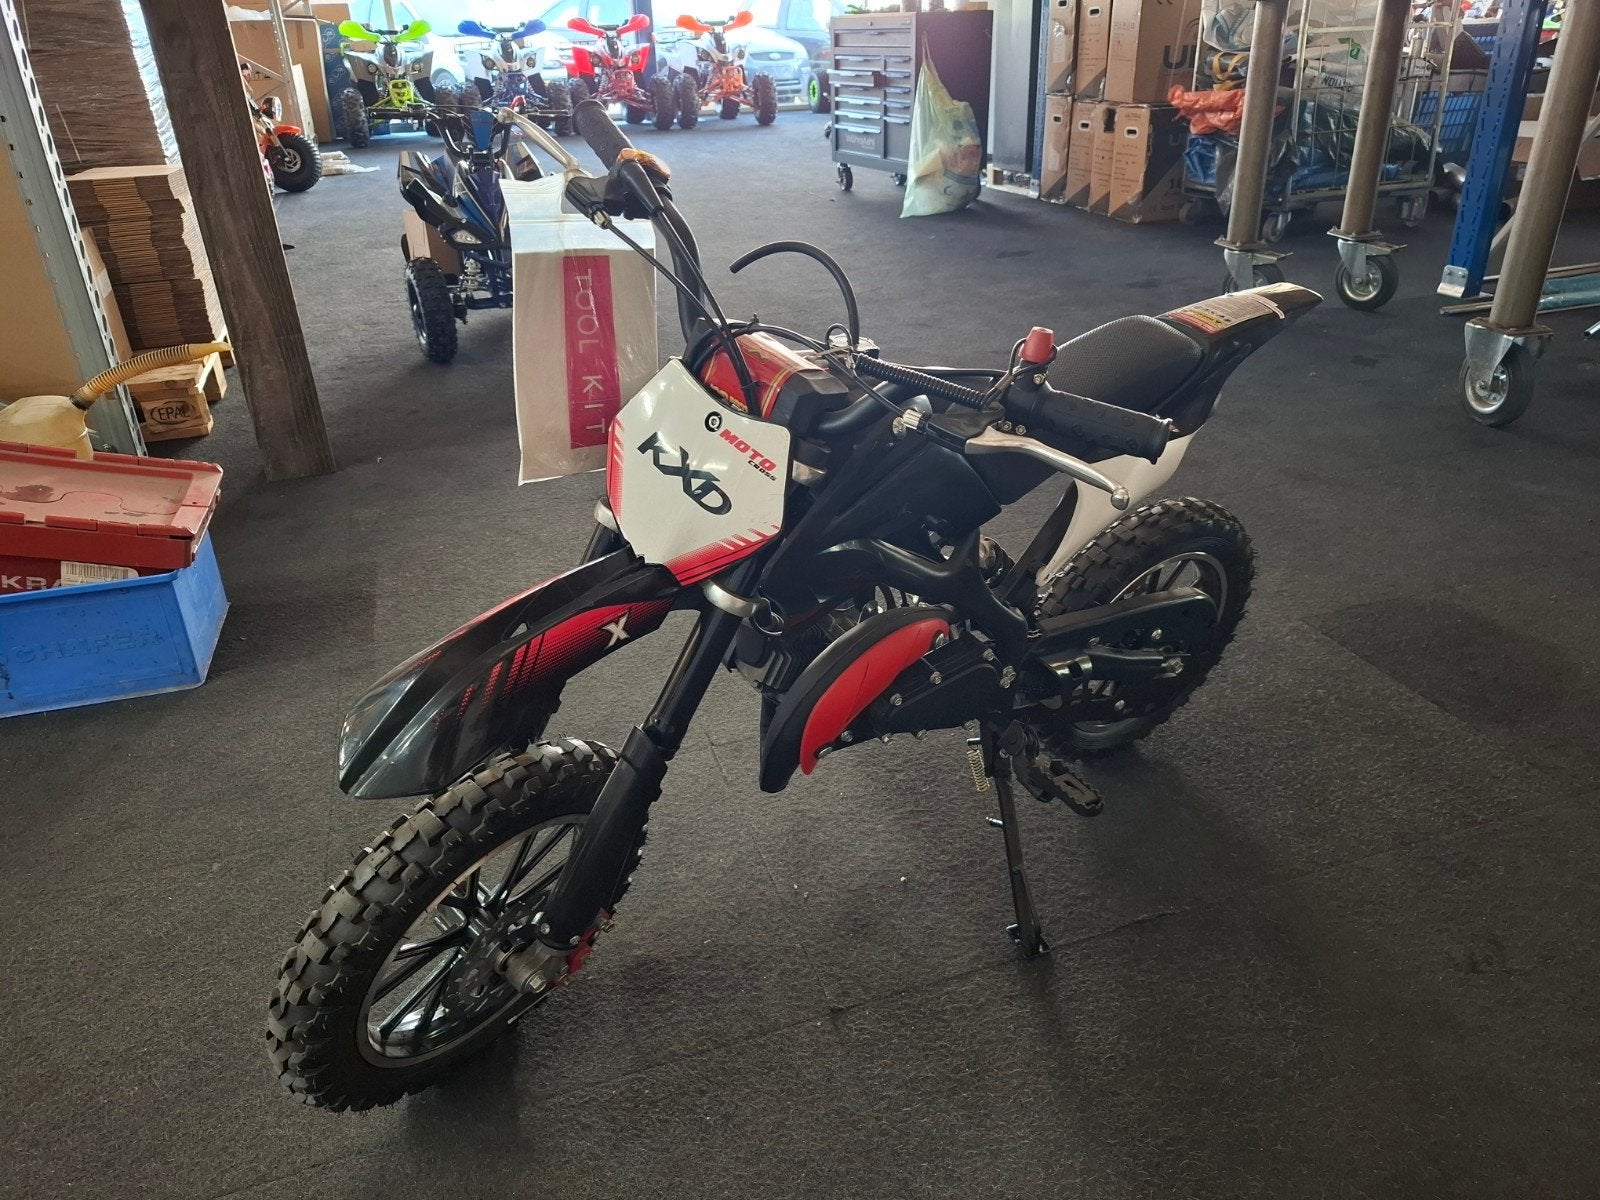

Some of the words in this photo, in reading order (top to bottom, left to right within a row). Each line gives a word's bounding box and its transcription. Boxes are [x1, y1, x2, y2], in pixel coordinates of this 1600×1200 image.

[575, 268, 599, 354] TOOL
[158, 404, 190, 421] EPAL
[582, 375, 605, 433] KIT
[637, 431, 733, 516] KXD
[719, 428, 777, 473] MOTO
[748, 460, 777, 482] CROSS
